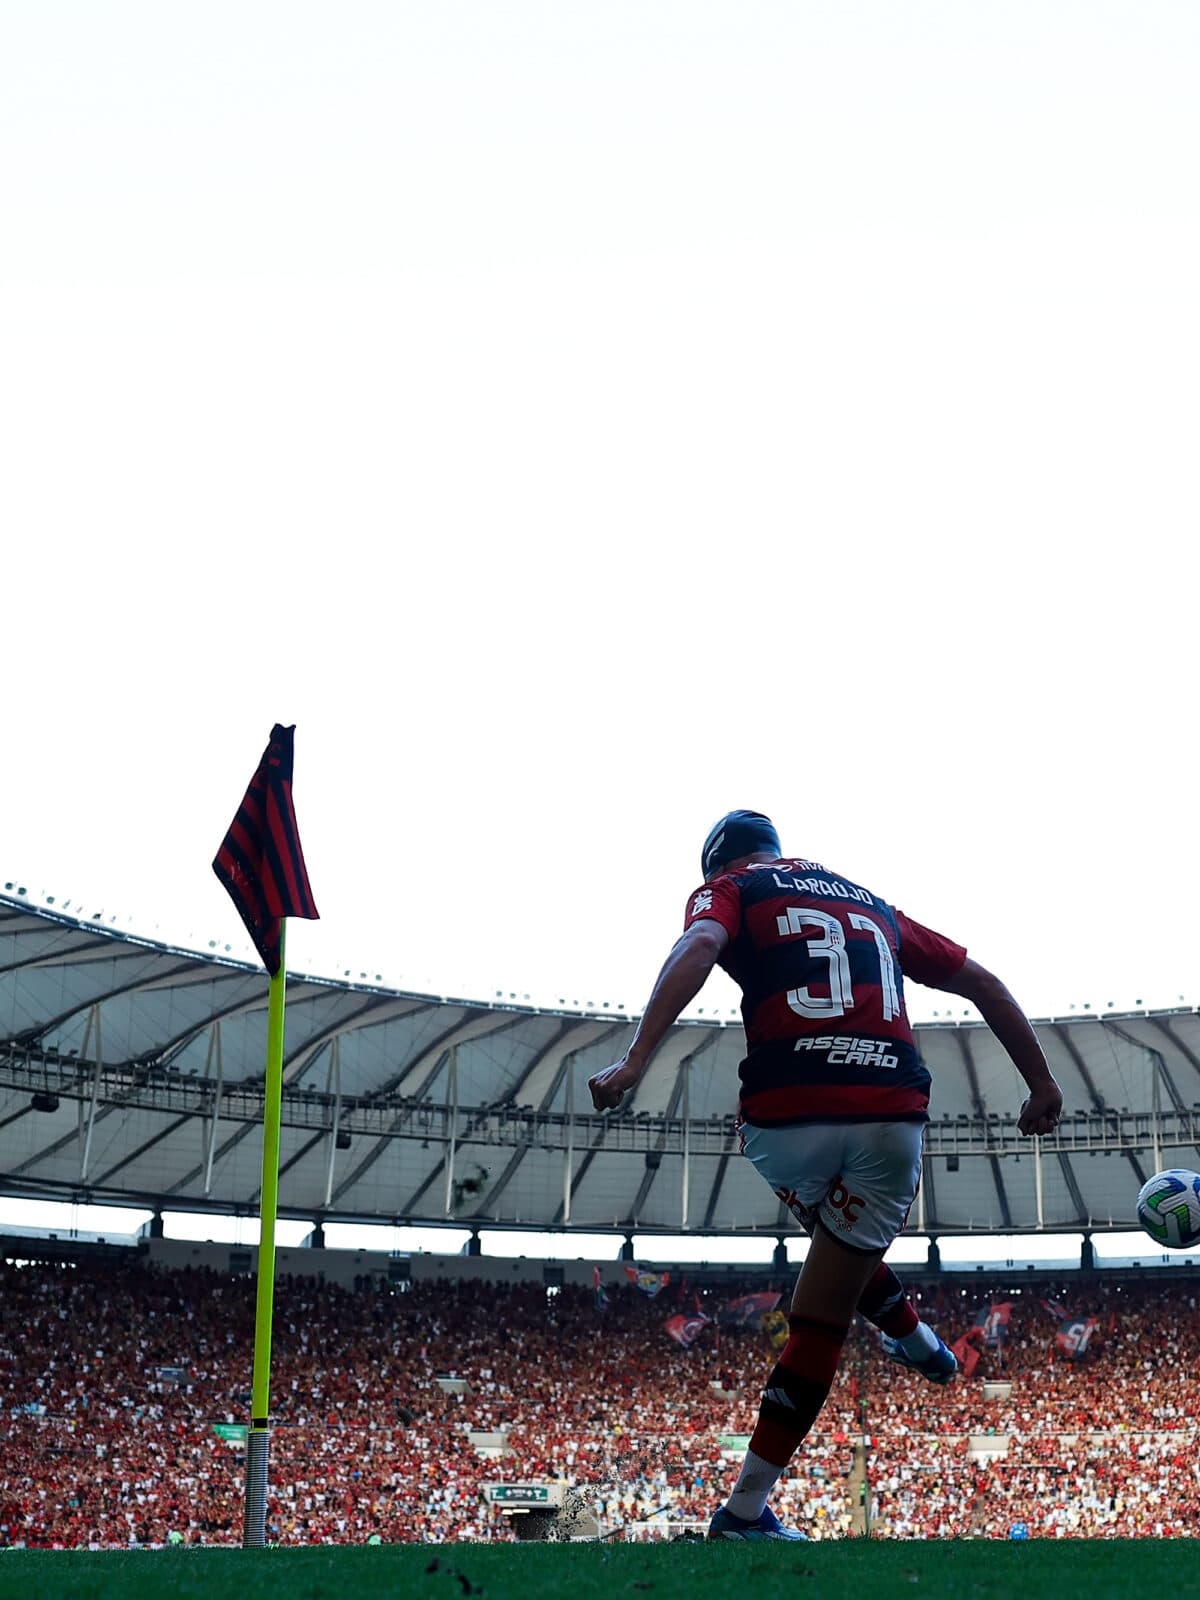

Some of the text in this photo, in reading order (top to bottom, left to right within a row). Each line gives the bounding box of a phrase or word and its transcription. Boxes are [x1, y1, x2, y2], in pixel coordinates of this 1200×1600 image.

[776, 907, 900, 1022] 37
[794, 1036, 892, 1053] ASSIST
[827, 1050, 898, 1068] CARD
